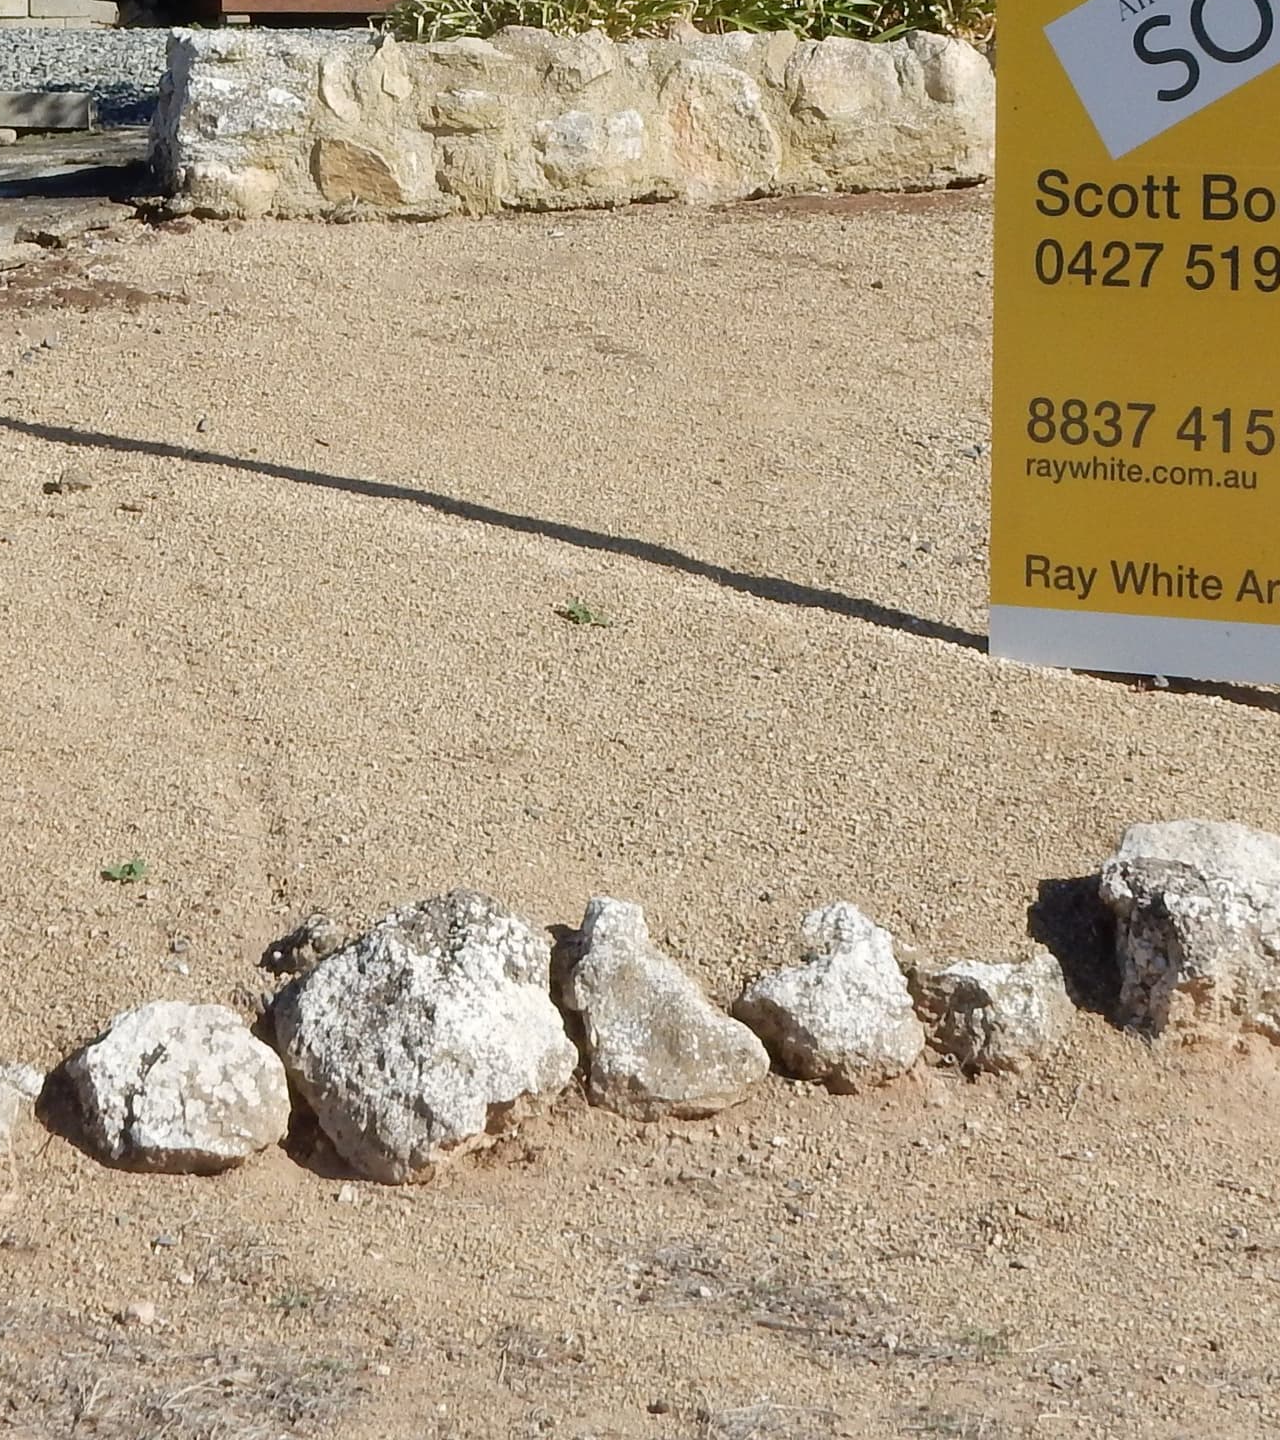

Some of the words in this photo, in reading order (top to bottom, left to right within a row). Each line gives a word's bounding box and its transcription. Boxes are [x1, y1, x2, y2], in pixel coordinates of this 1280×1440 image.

[1036, 169, 1180, 220] Scott
[1035, 239, 1164, 288] 0427
[1026, 397, 1156, 448] 8837
[1026, 456, 1258, 489] raywhite.com.au
[1025, 554, 1097, 600] Ray
[1110, 560, 1223, 600] White
